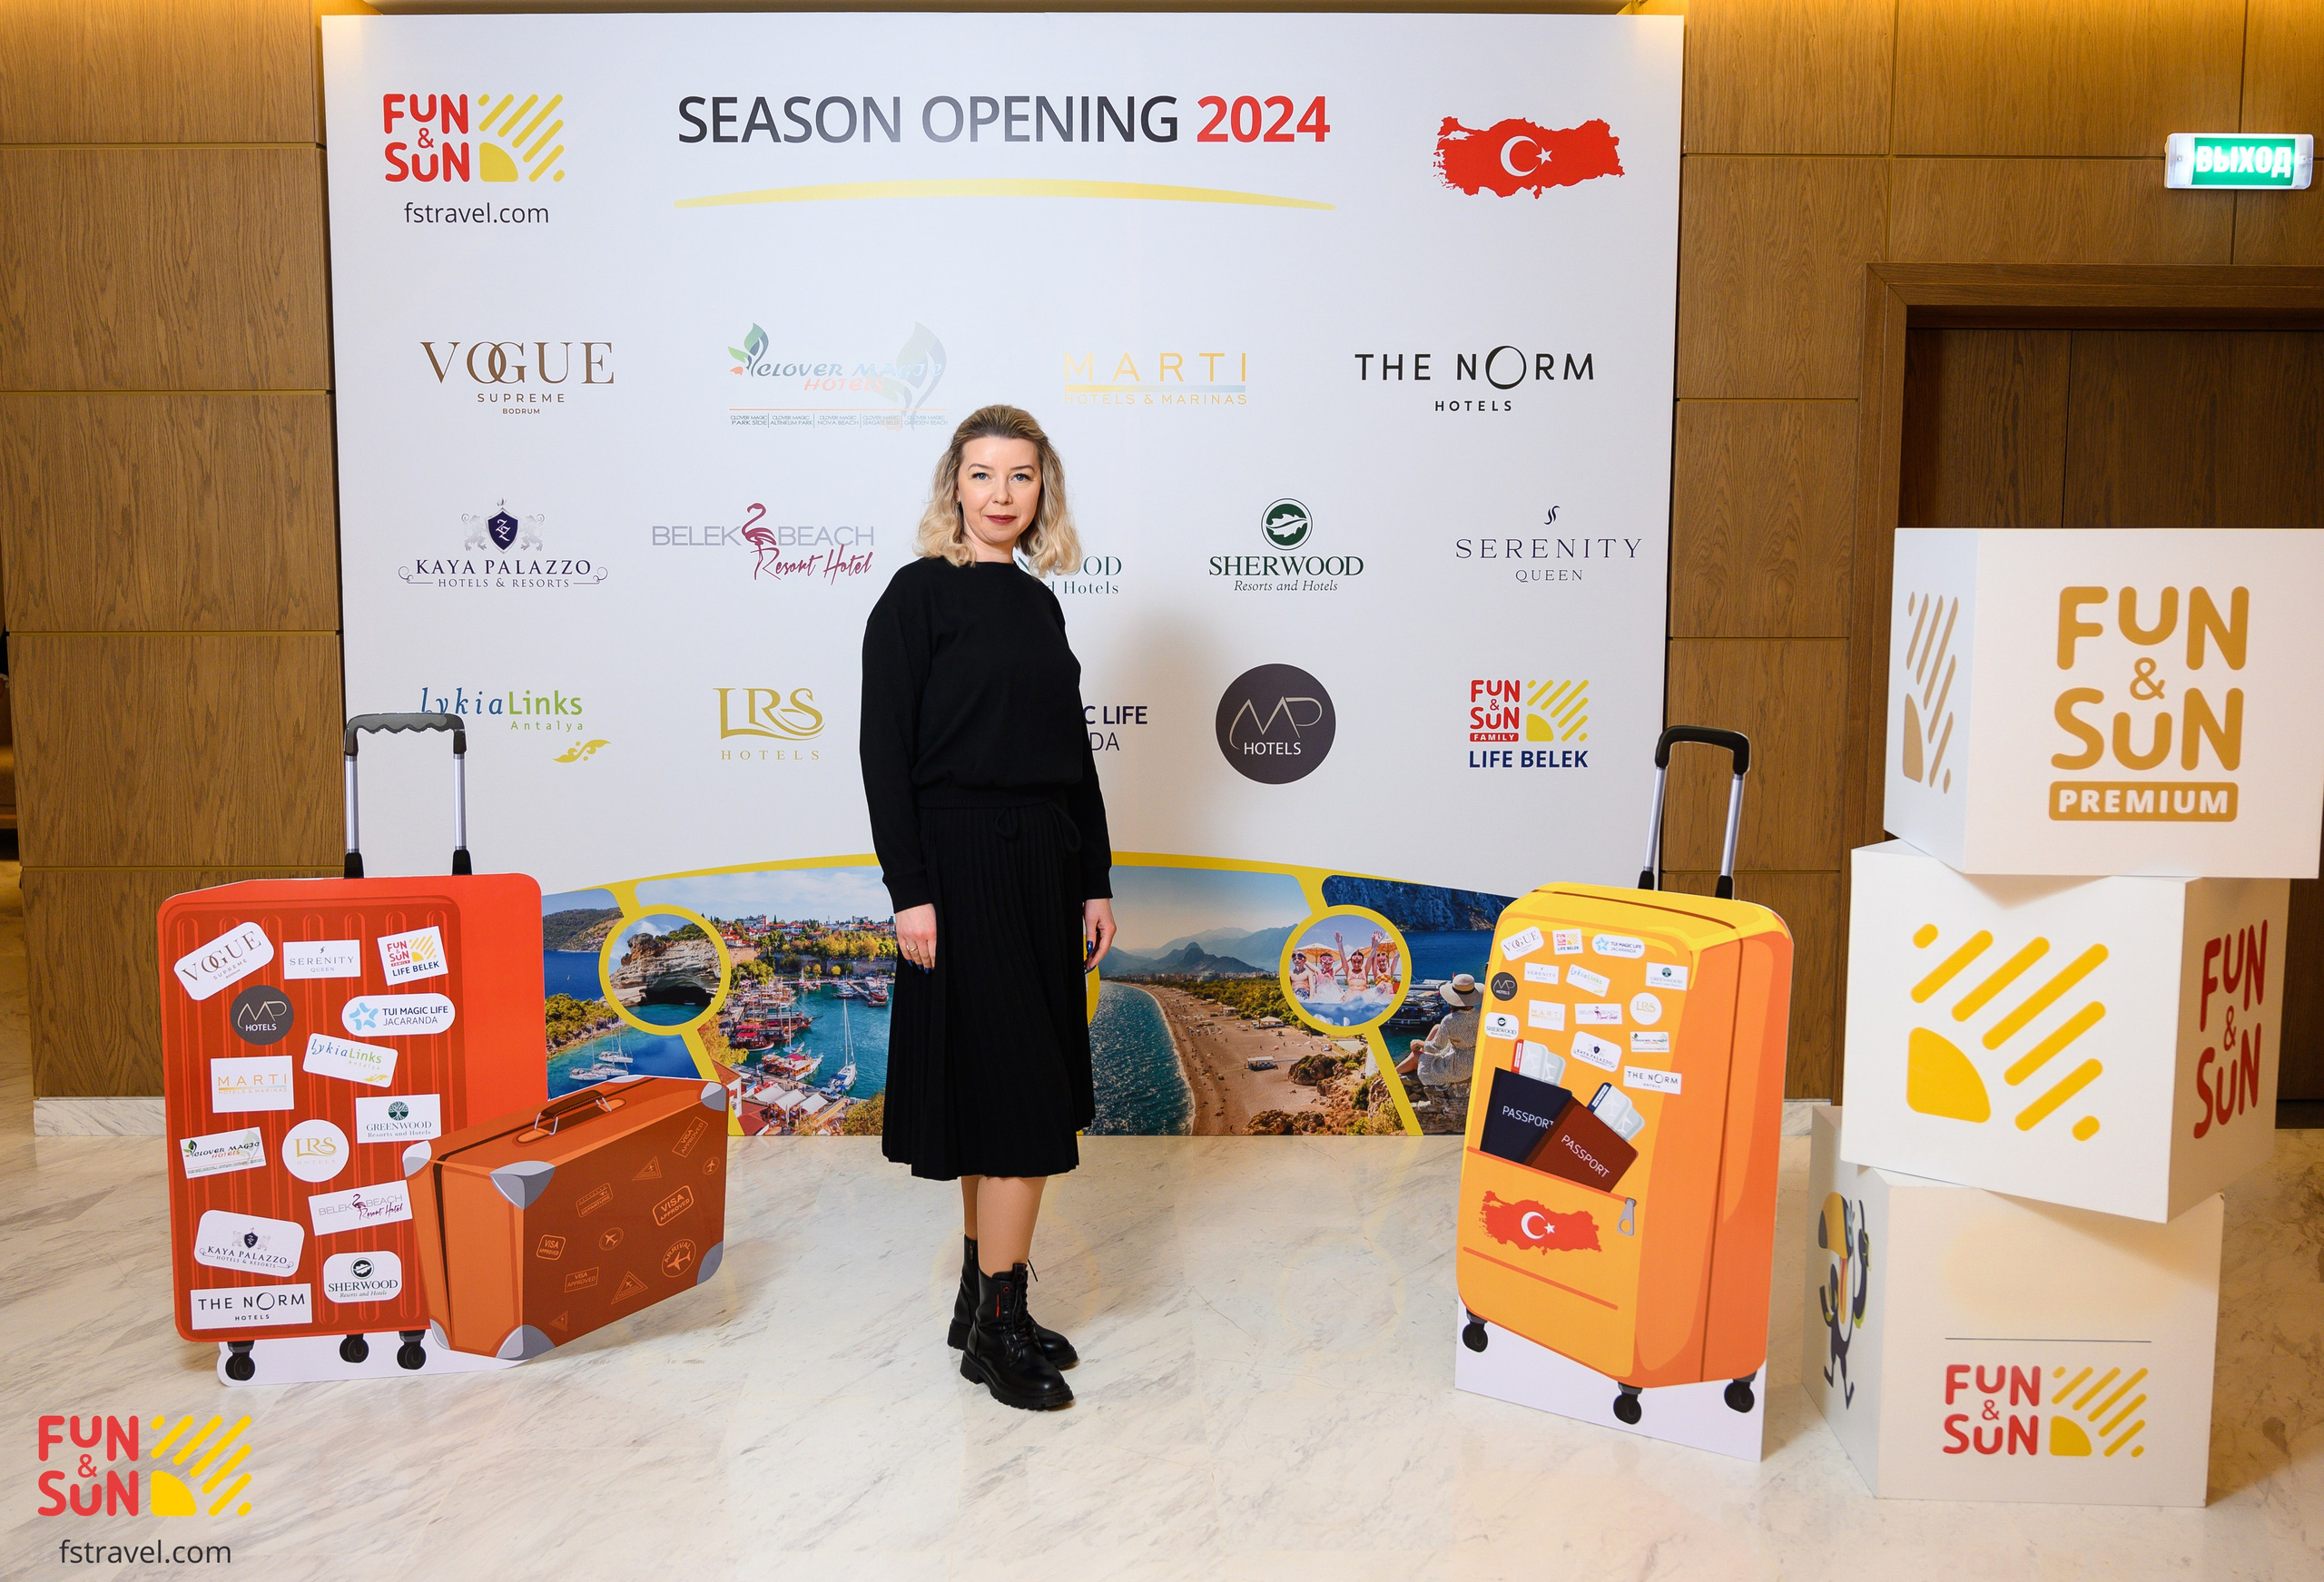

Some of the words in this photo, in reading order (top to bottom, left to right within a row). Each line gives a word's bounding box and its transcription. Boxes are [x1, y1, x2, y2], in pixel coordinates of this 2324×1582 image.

[384, 93, 469, 134] FUN
[678, 95, 901, 143] SEASON
[921, 95, 1178, 143] OPENING
[1196, 95, 1331, 142] 2024
[418, 128, 435, 149] &
[385, 142, 469, 182] SUN
[2196, 146, 2291, 178] ВЫХОД
[405, 202, 549, 223] fstravel.com
[420, 341, 615, 385] VOGUE
[757, 363, 842, 377] CLOVER
[1065, 353, 1246, 382] MARTI
[1354, 354, 1432, 381] THE
[1457, 345, 1594, 390] NORM
[478, 393, 565, 404] SUPREME
[1065, 394, 1137, 405] HOTELS
[1144, 394, 1154, 405] &
[1161, 394, 1247, 406] MARINAS
[1435, 401, 1512, 412] HOTELS
[653, 526, 742, 546] BELEK
[778, 526, 874, 546] BEACH
[1455, 538, 1642, 559] SERENITY
[416, 559, 476, 575] KAYA
[485, 559, 592, 575] PALAZZO
[750, 546, 823, 580] Resort
[823, 545, 873, 585] Hotel
[1209, 555, 1364, 576] SHERWOOD
[438, 578, 488, 588] HOTELS
[497, 577, 505, 588] &
[513, 578, 570, 588] RESORTS
[1234, 580, 1273, 592] Resorts
[1276, 580, 1298, 592] and
[1302, 580, 1338, 592] Hotels
[1515, 570, 1583, 583] QUEEN
[1064, 581, 1119, 594] Hotels
[2057, 585, 2250, 671] FUN
[2130, 657, 2165, 701] &
[1471, 680, 1521, 703] FUN
[713, 688, 825, 741] LRS
[1490, 699, 1500, 711] &
[1103, 706, 1147, 724] LIFE
[1470, 706, 1520, 730] SUN
[511, 721, 583, 732] Antalya
[2051, 687, 2244, 771] SUN
[1474, 733, 1515, 742] FAMILY
[721, 750, 820, 761] HOTELS
[1244, 742, 1301, 755] HOTELS
[1469, 751, 1513, 768] LIFE
[1521, 751, 1589, 768] BELEK
[2058, 789, 2229, 815] PREMIUM
[182, 930, 261, 981] VOGUE
[387, 940, 408, 952] FUN
[290, 956, 354, 966] SERENITY
[389, 950, 409, 962] SUN
[213, 958, 248, 980] SUPREME
[392, 967, 410, 977] LIFE
[413, 961, 439, 973] BELEK
[2201, 919, 2269, 1032] FUN
[382, 1007, 398, 1016] TUI
[400, 1006, 428, 1015] MAGIC
[430, 1006, 448, 1014] LIFE
[245, 1023, 277, 1032] HOTELS
[383, 1017, 438, 1026] JACARANDA
[2223, 1005, 2237, 1051] &
[218, 1074, 287, 1087] MARTI
[1627, 1071, 1643, 1079] THE
[1648, 1073, 1678, 1084] NORM
[2193, 1022, 2261, 1139] SUN
[366, 1121, 432, 1132] GREENWOOD
[681, 1129, 694, 1144] VISA
[681, 1122, 704, 1154] APPROVED
[294, 1136, 337, 1157] LRS
[1561, 1135, 1610, 1177] PASSPORT
[319, 1203, 353, 1215] BELEK
[366, 1194, 403, 1207] BEACH
[581, 1195, 610, 1215] DEPARTURE
[660, 1198, 690, 1222] APPROVED
[661, 1194, 684, 1212] VISA
[545, 1239, 558, 1249] VISA
[664, 1241, 691, 1263] ARRIVAL
[208, 1246, 234, 1257] KAYA
[239, 1251, 287, 1264] PALAZZO
[216, 1255, 240, 1263] HOTELS
[250, 1260, 276, 1268] RESORTS
[328, 1279, 399, 1292] SHERWOOD
[567, 1275, 596, 1288] APPROVED
[575, 1272, 587, 1280] VISA
[198, 1298, 232, 1311] THE
[243, 1292, 305, 1311] NORM
[1945, 1364, 2041, 1406] FUN
[1982, 1399, 2000, 1420] &
[1942, 1413, 2039, 1455] SUN
